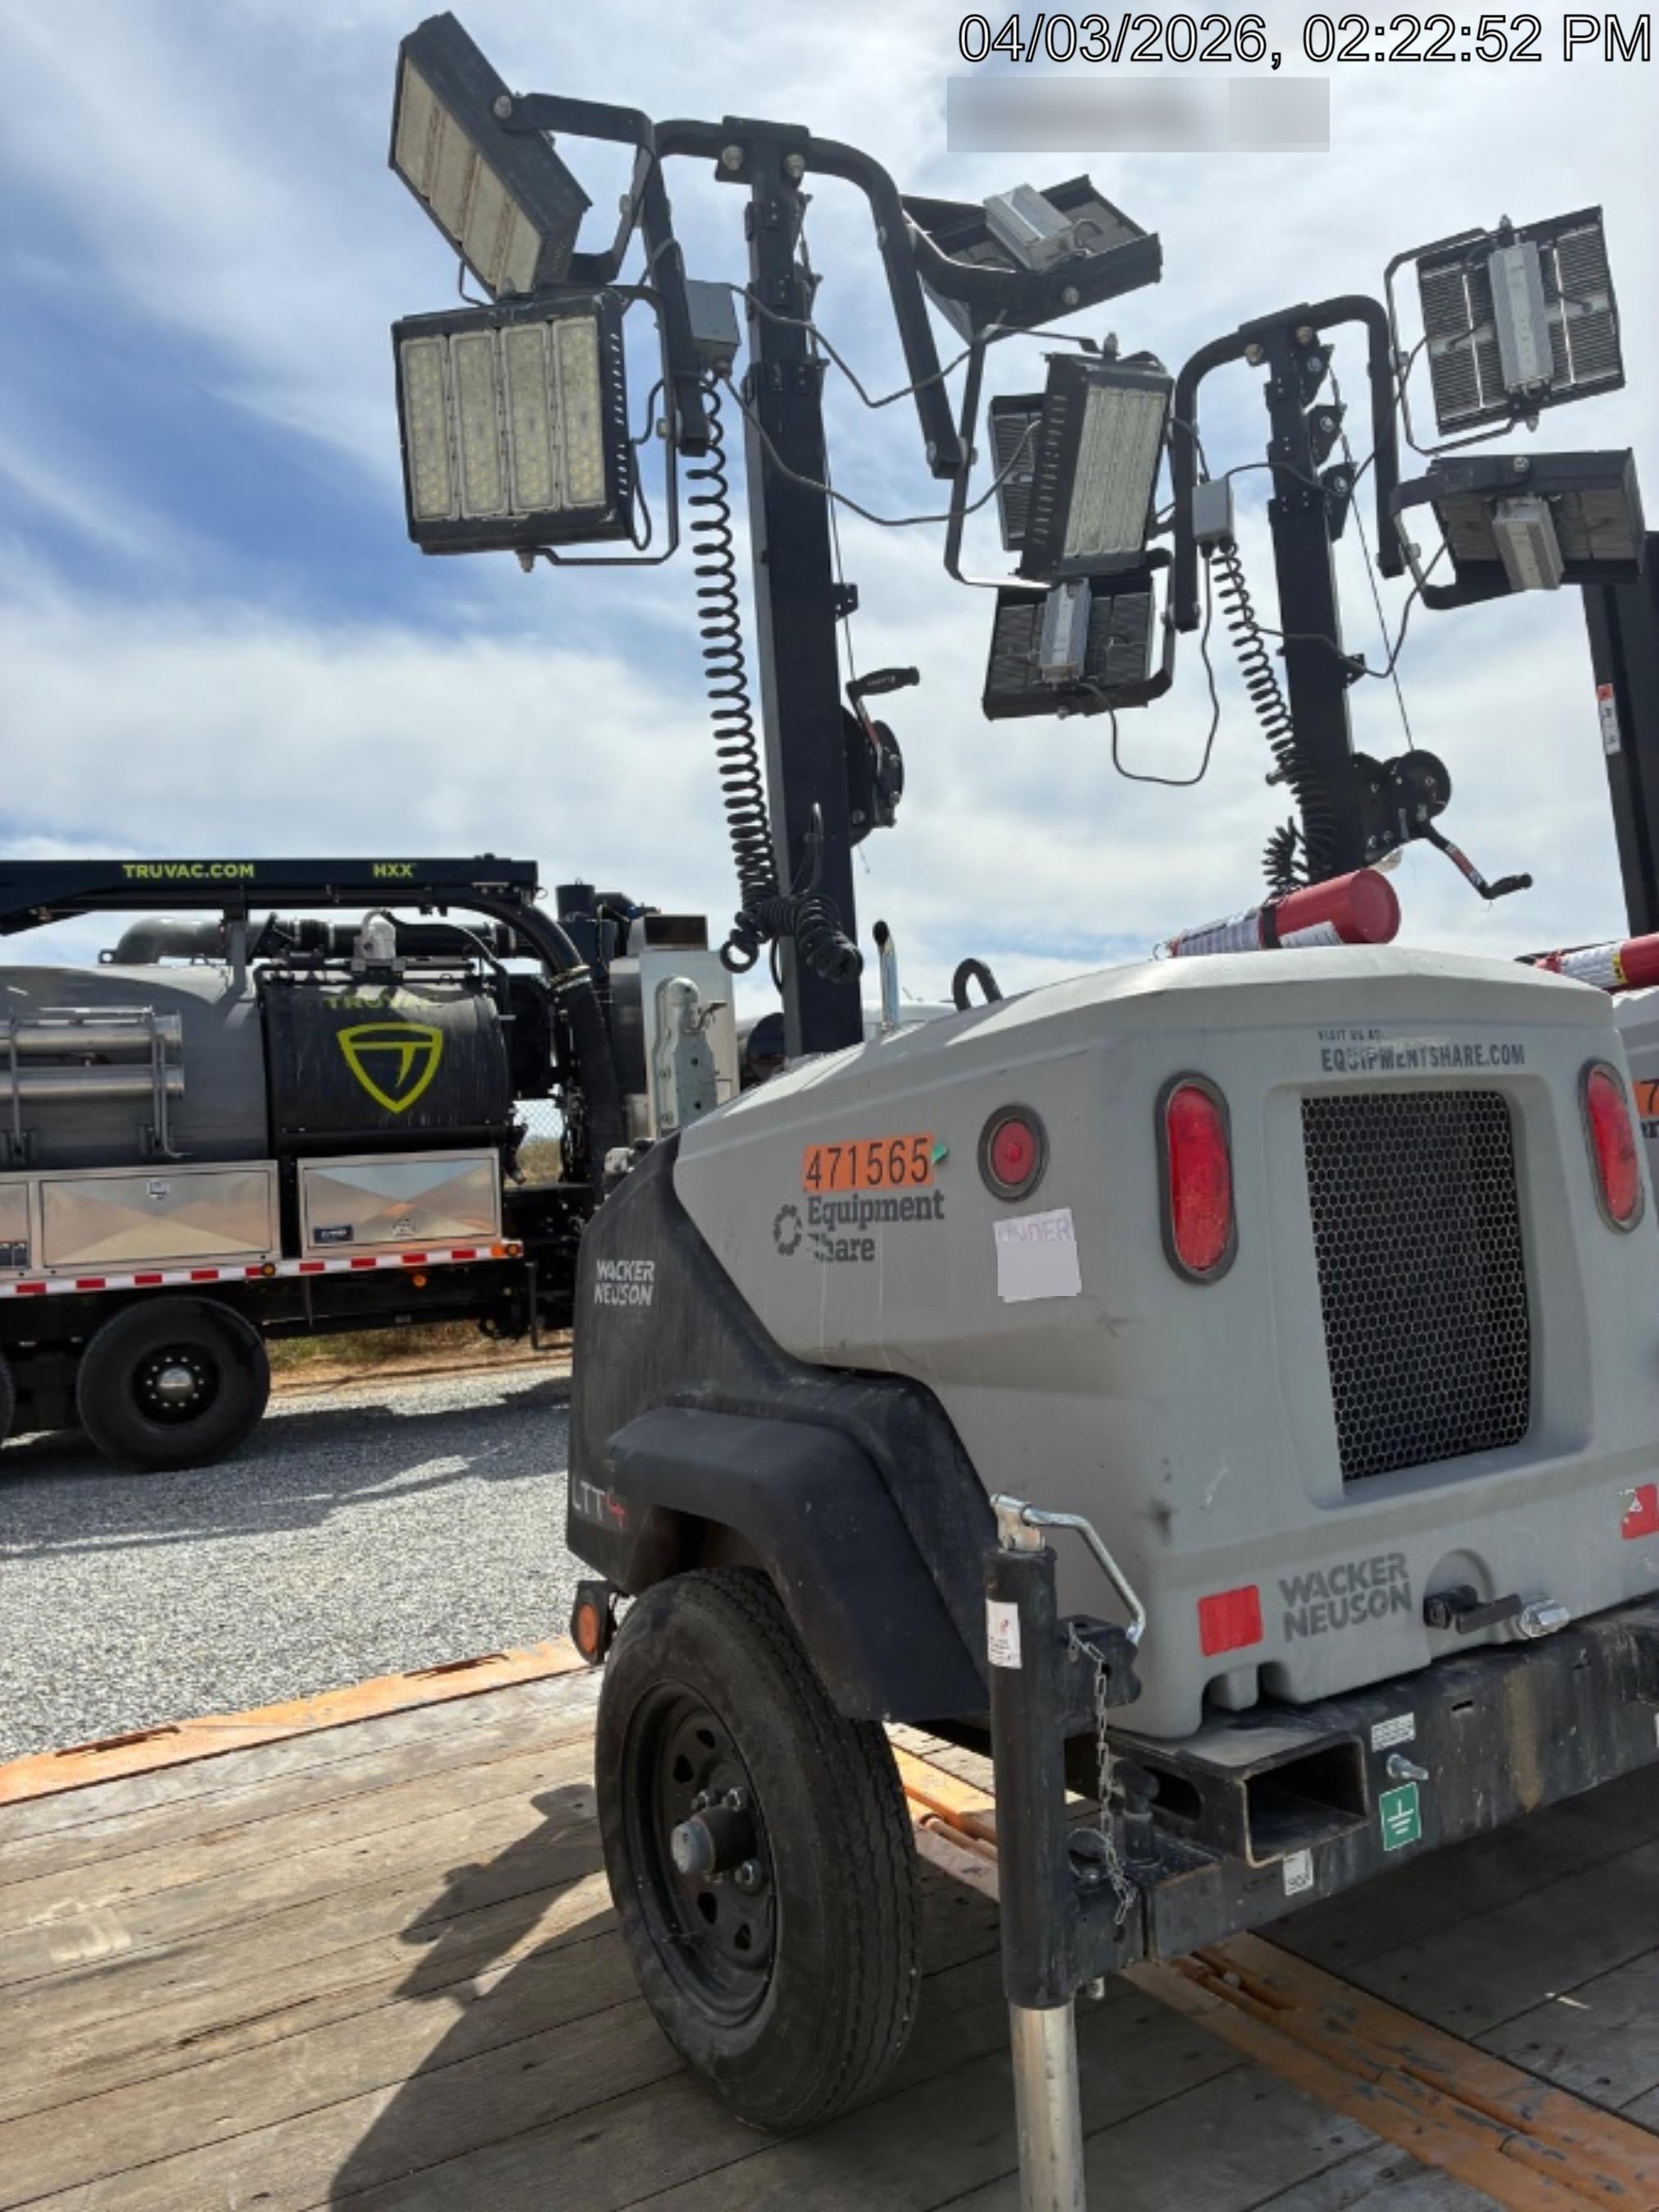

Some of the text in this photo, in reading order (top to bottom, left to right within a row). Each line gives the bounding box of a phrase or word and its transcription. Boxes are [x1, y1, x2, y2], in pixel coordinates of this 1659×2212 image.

[124, 864, 255, 878] TRUVAC.COM
[806, 1138, 928, 1190] 471565
[808, 1190, 945, 1231] Equipment
[596, 1260, 655, 1282] WACKER
[594, 1283, 654, 1305] NEUSON
[1278, 1552, 1409, 1608] WACKER
[1284, 1581, 1412, 1643] NEUSON
